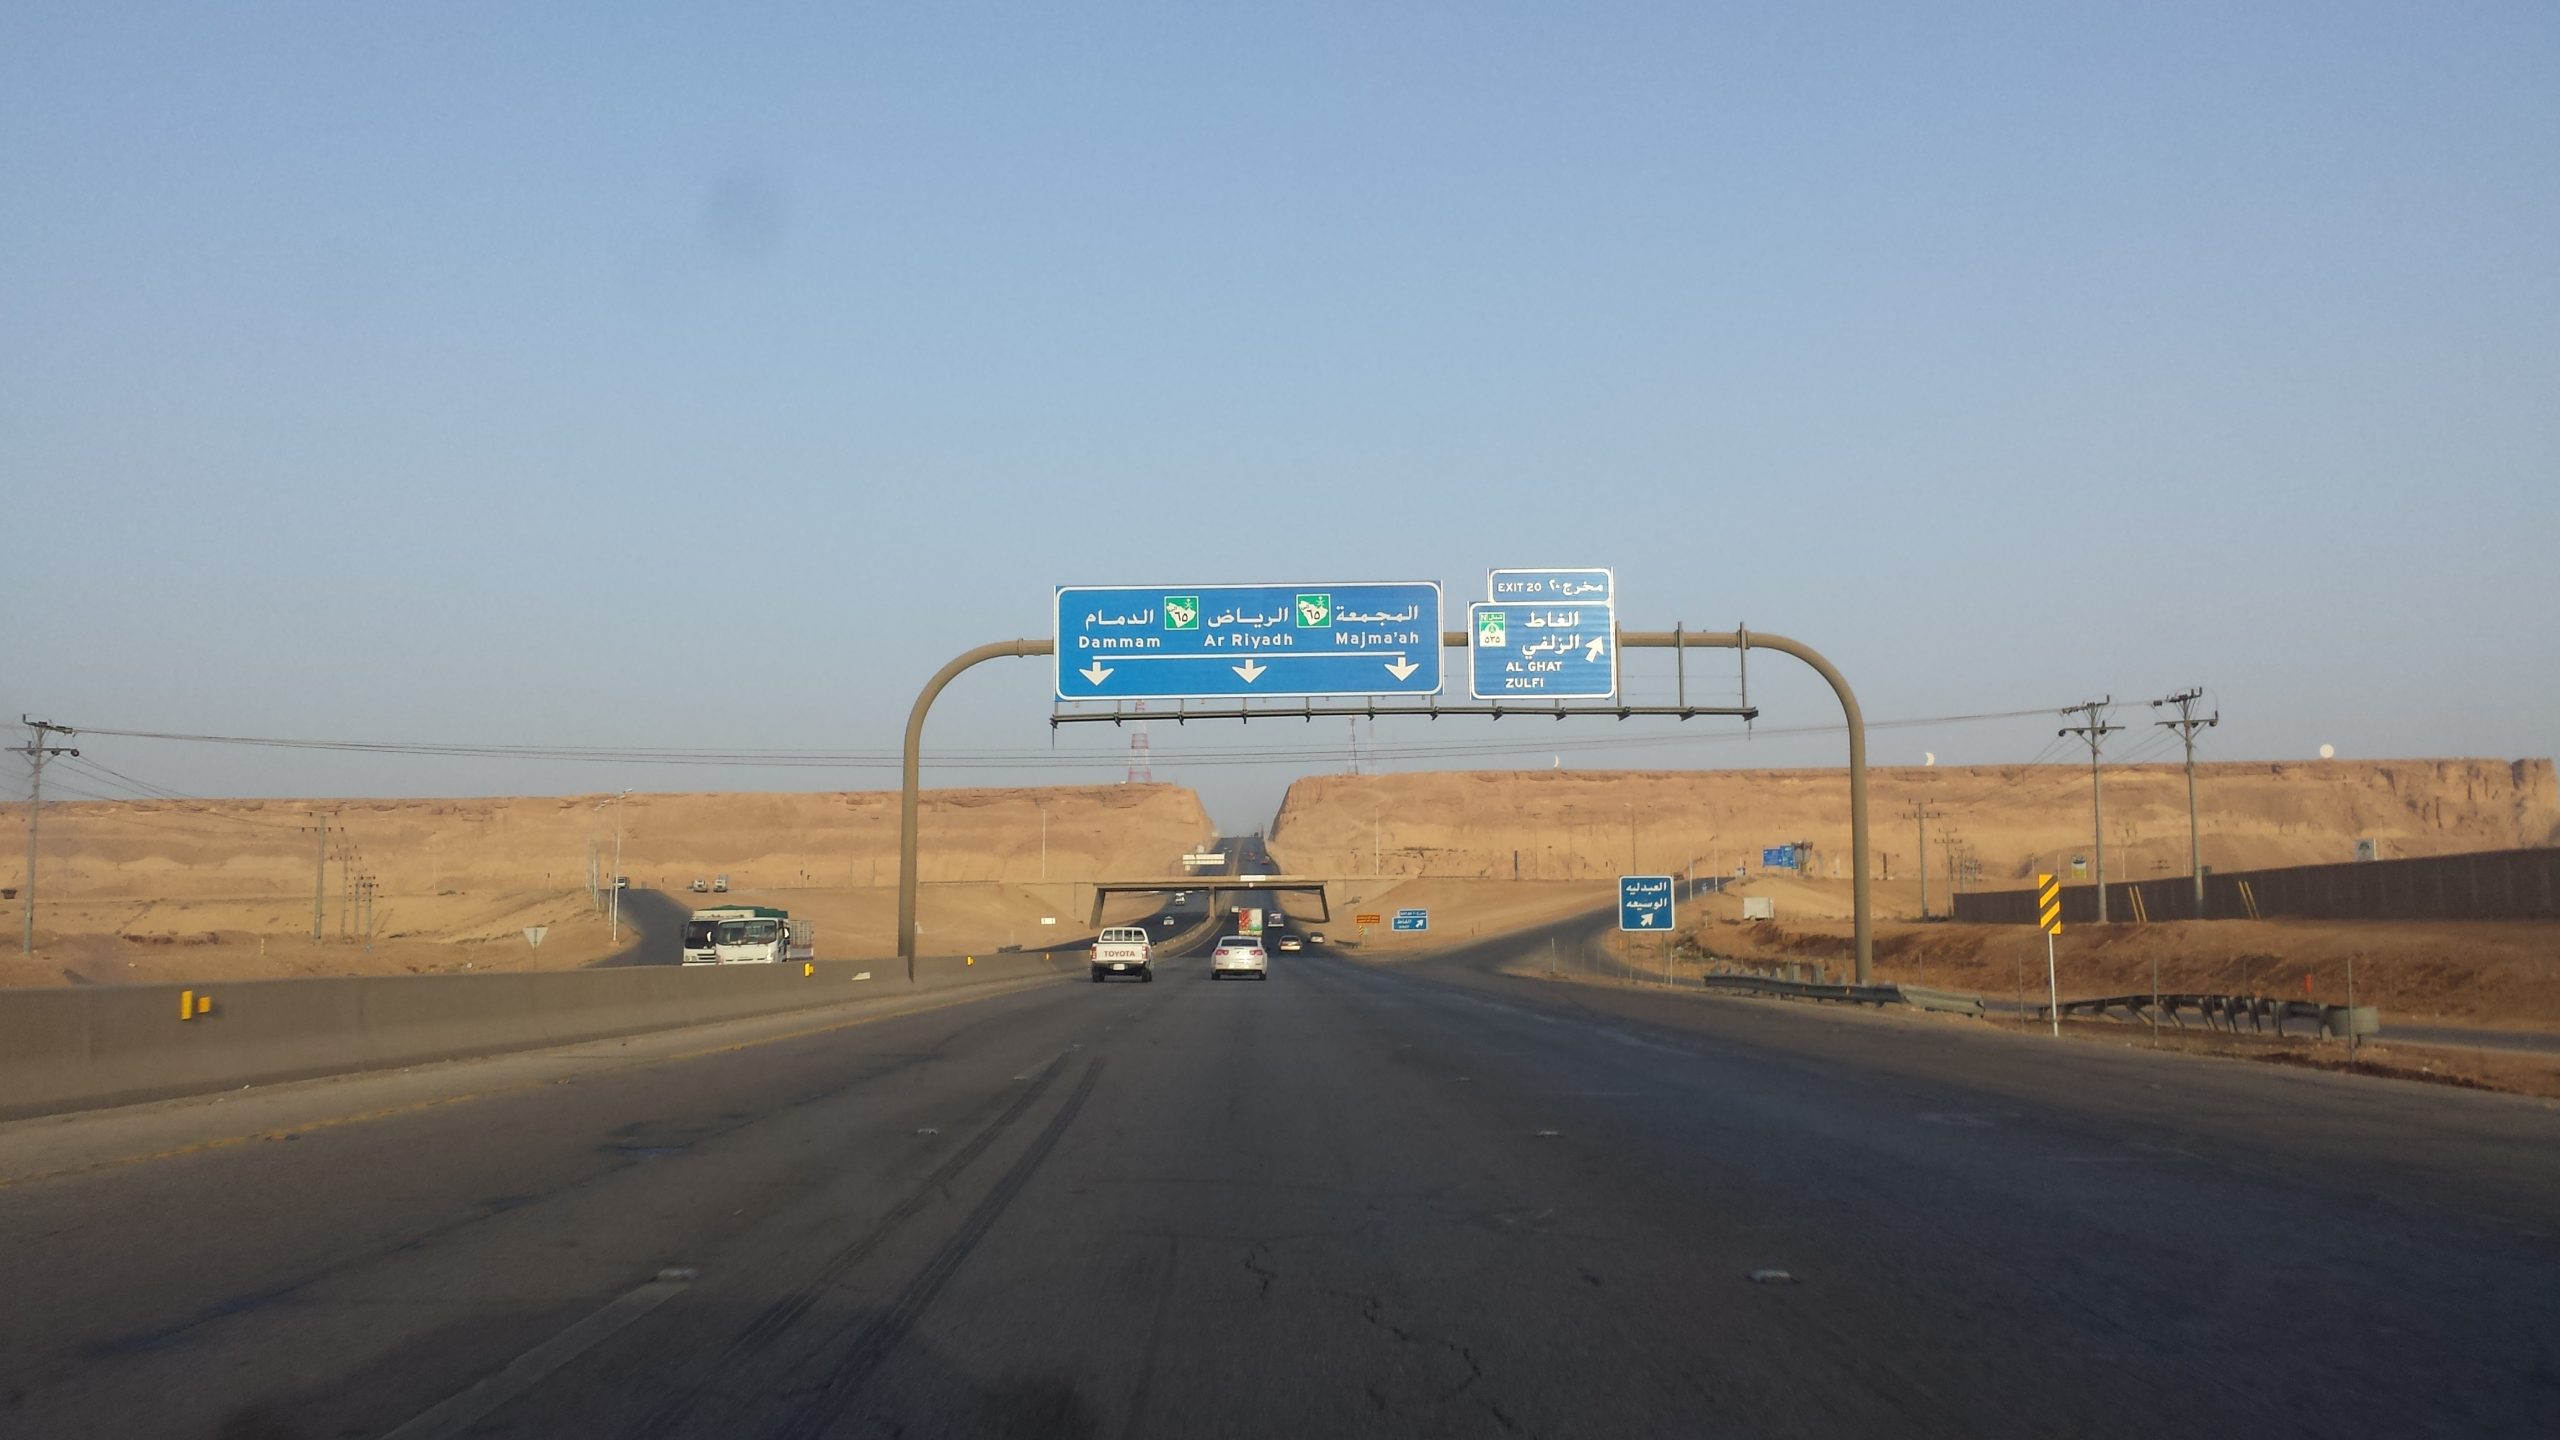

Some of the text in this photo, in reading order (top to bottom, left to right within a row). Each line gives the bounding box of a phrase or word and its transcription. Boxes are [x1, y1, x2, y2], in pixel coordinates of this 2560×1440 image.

[1498, 582, 1542, 592] EXIT 20
[1548, 579, 1604, 596] مخرج ٢٠
[1085, 608, 1154, 631] الدمام
[1174, 611, 1188, 622] ٦٥
[1207, 606, 1289, 628] الرياض
[1306, 609, 1320, 620] ٦٥
[1336, 604, 1418, 626] المجمعة
[1524, 610, 1579, 627] الغاط
[1079, 635, 1160, 648] Dammam
[1204, 633, 1293, 649] Ar Riyadh
[1335, 631, 1419, 649] Majma'ah
[1522, 633, 1580, 660] الزلفي
[1505, 661, 1562, 672] AL GHAT
[1505, 677, 1544, 688] ZULFI
[1626, 881, 1667, 895] العبدليه
[1626, 897, 1667, 911] الوسيعه
